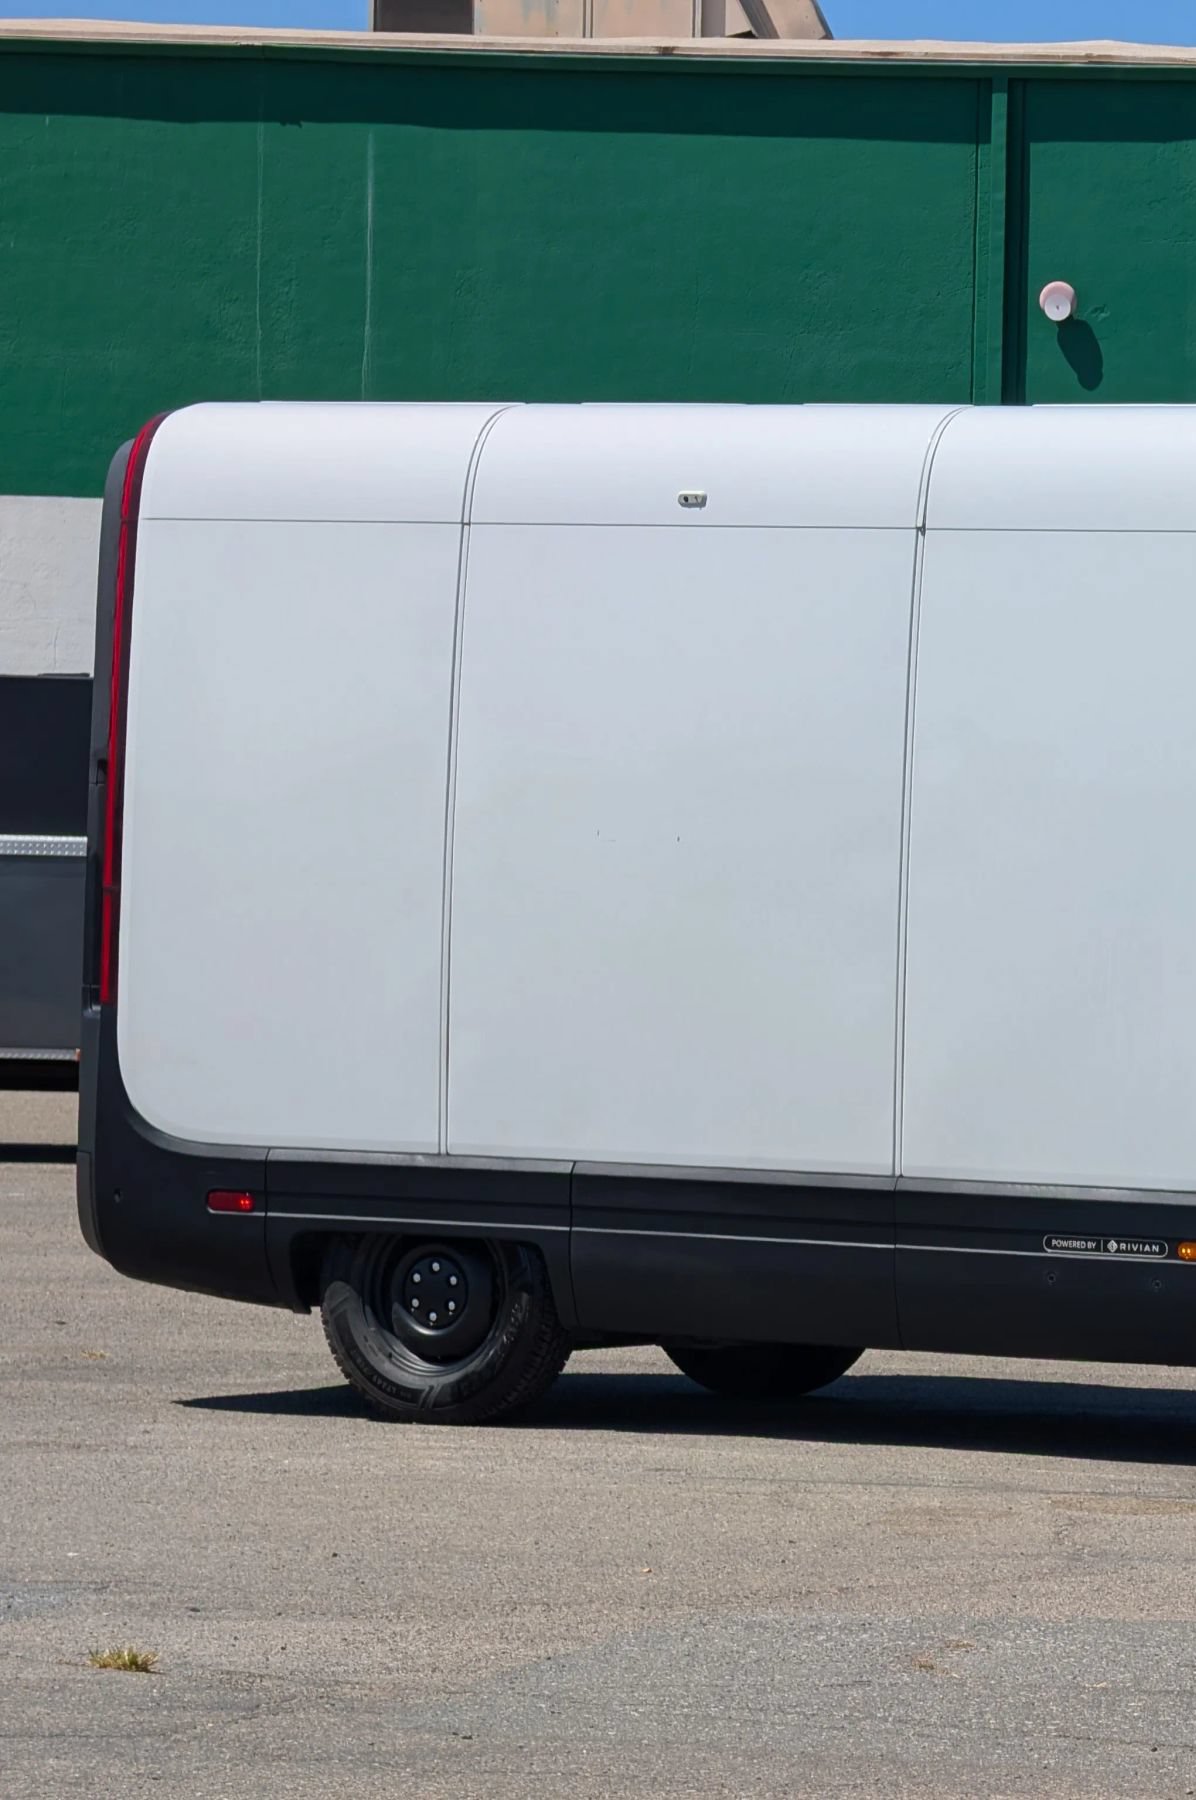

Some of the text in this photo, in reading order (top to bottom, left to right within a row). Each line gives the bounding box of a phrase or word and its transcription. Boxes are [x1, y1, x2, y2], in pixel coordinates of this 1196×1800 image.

[1051, 1239, 1160, 1253] POWERED BY RIVIAN
